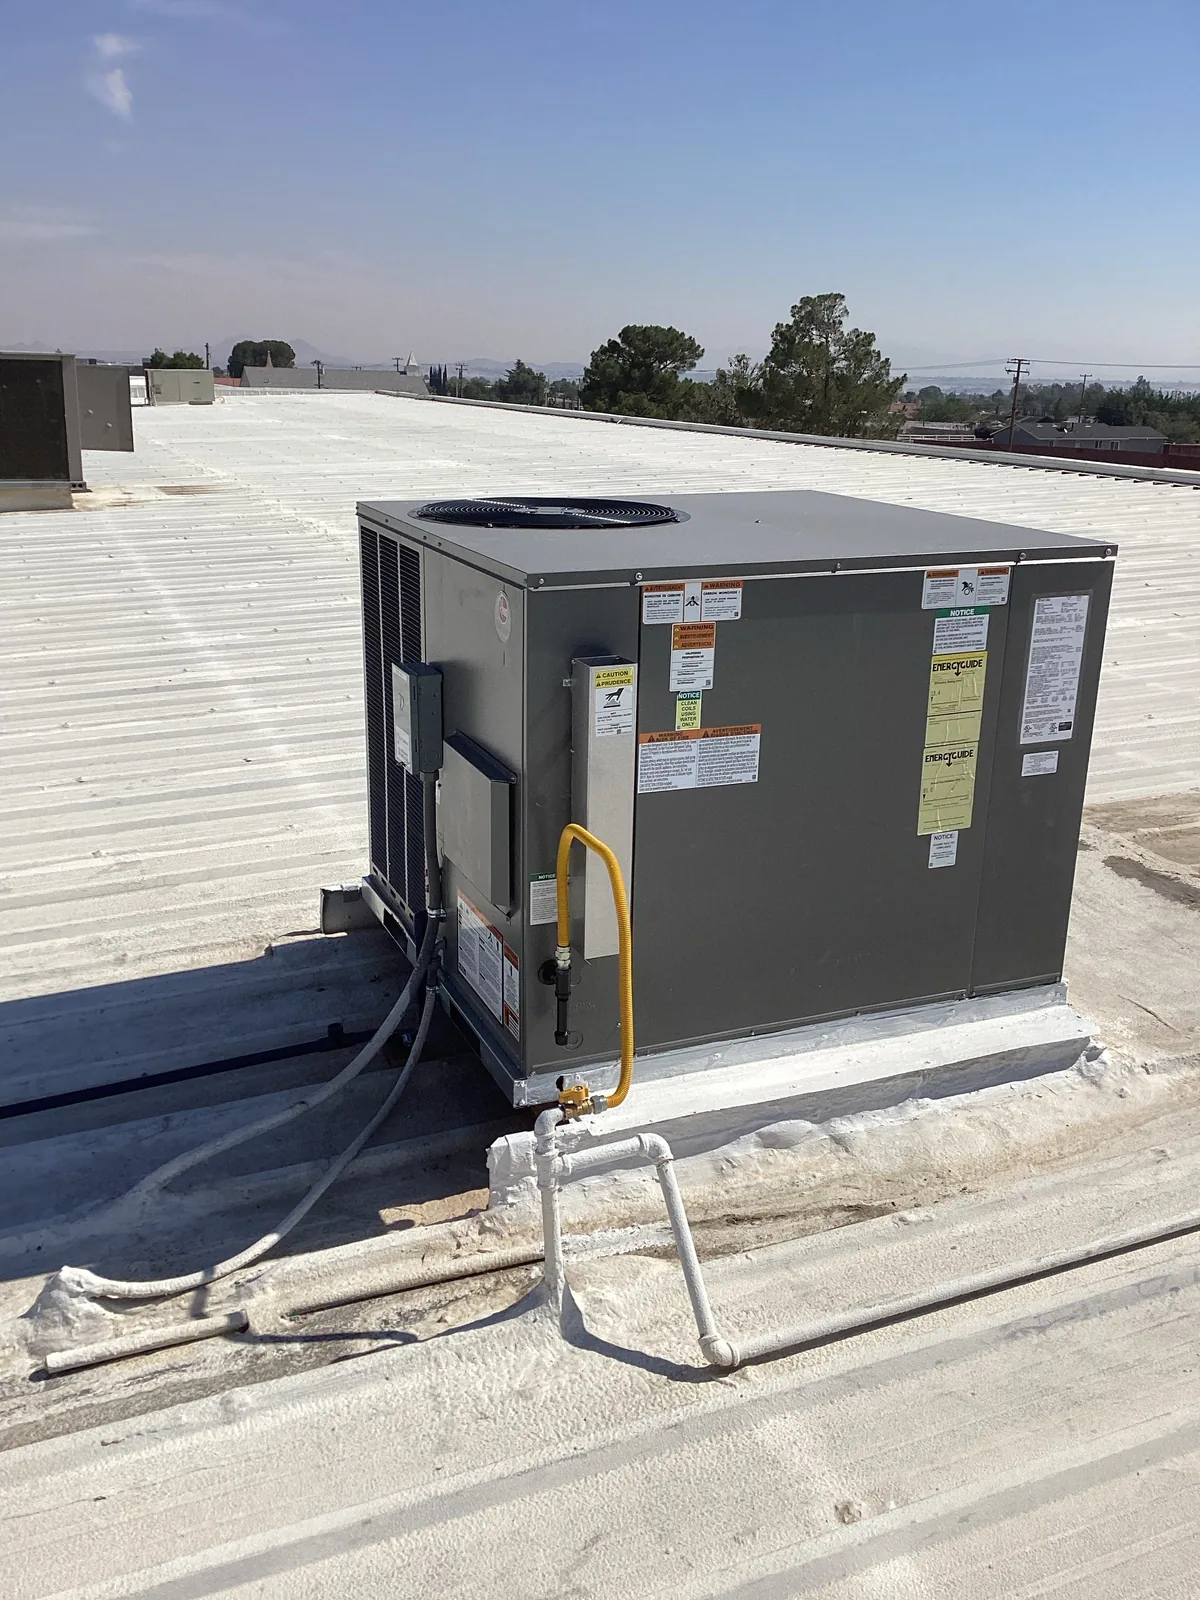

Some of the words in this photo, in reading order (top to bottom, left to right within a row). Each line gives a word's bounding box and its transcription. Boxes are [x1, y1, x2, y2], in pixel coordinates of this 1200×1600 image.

[709, 581, 741, 589] WARNING
[950, 608, 975, 617] NOTICE
[932, 659, 983, 672] ENERGYGUIDE
[601, 678, 631, 686] PRUDENCE
[925, 750, 974, 763] ENERGYGUIDE
